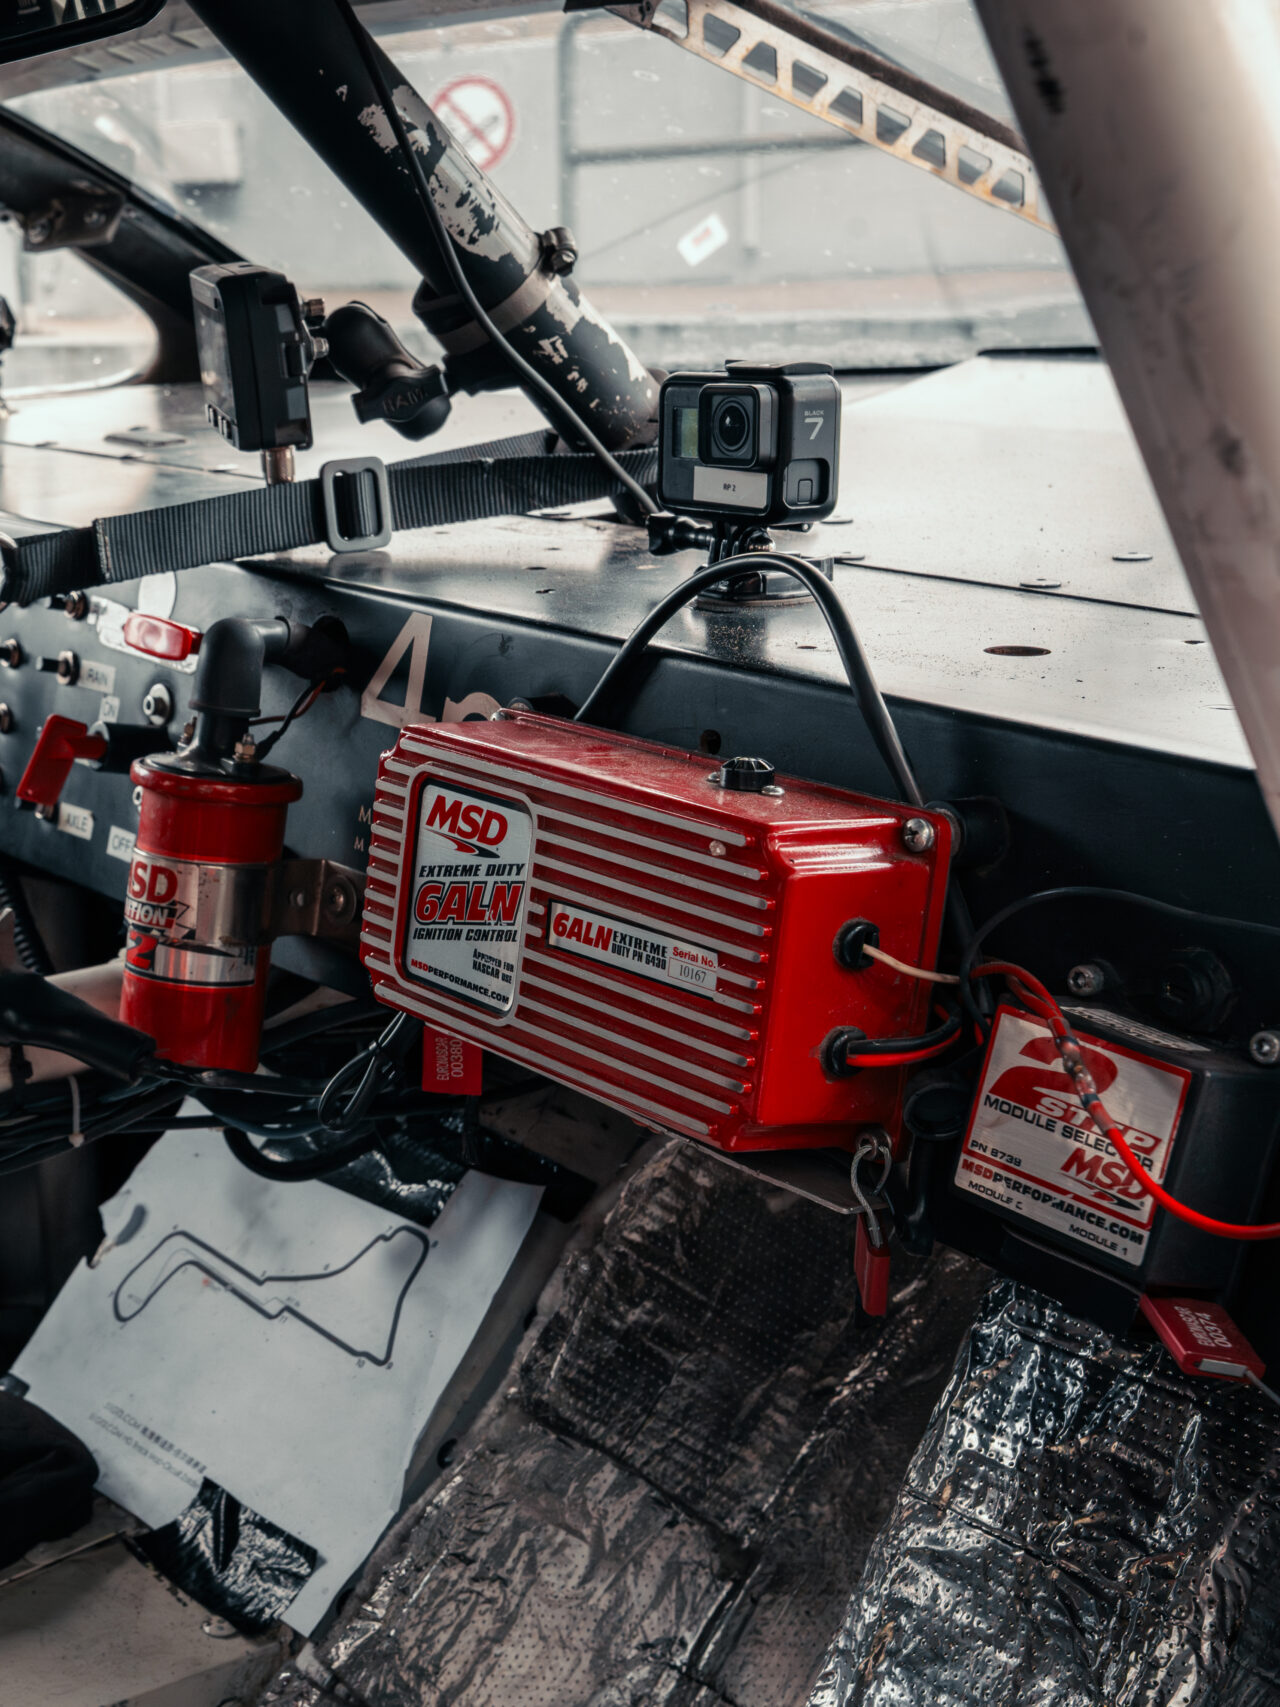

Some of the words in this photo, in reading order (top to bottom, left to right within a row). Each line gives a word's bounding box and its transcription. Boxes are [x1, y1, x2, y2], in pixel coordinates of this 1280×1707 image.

[804, 417, 824, 440] 7
[723, 483, 731, 491] RP
[425, 794, 508, 846] MSD
[112, 834, 133, 851] OFF
[128, 860, 178, 904] SD
[419, 864, 482, 878] EXTREME
[485, 863, 525, 877] DUTY
[414, 880, 525, 926] 6ALN
[413, 927, 463, 941] IGNITION
[465, 929, 517, 942] CONTROL
[553, 912, 613, 952] 6ALN
[613, 931, 668, 958] EXTREME
[611, 943, 630, 959] DUTY
[632, 951, 643, 963] PN
[645, 955, 667, 970] 6430
[672, 946, 699, 963] Serial
[701, 956, 716, 969] No.
[411, 958, 510, 1005] MSDPERFORMANCE.COM
[472, 960, 500, 979] NASCAR
[501, 973, 512, 984] USE
[679, 964, 707, 983] 10167
[450, 1039, 464, 1078] 00380
[983, 1095, 1057, 1133] MODULE
[1061, 1124, 1154, 1172] SELECR
[1035, 1096, 1155, 1149] STP
[970, 1140, 988, 1154] PN
[990, 1148, 1023, 1168] 8739
[1060, 1147, 1152, 1200] MSD
[961, 1158, 1144, 1246] MSDPERFORMANCE.COM
[968, 1180, 1011, 1204] MODULE
[1069, 1223, 1118, 1251] MODULE
[1194, 1311, 1233, 1348] 00374
